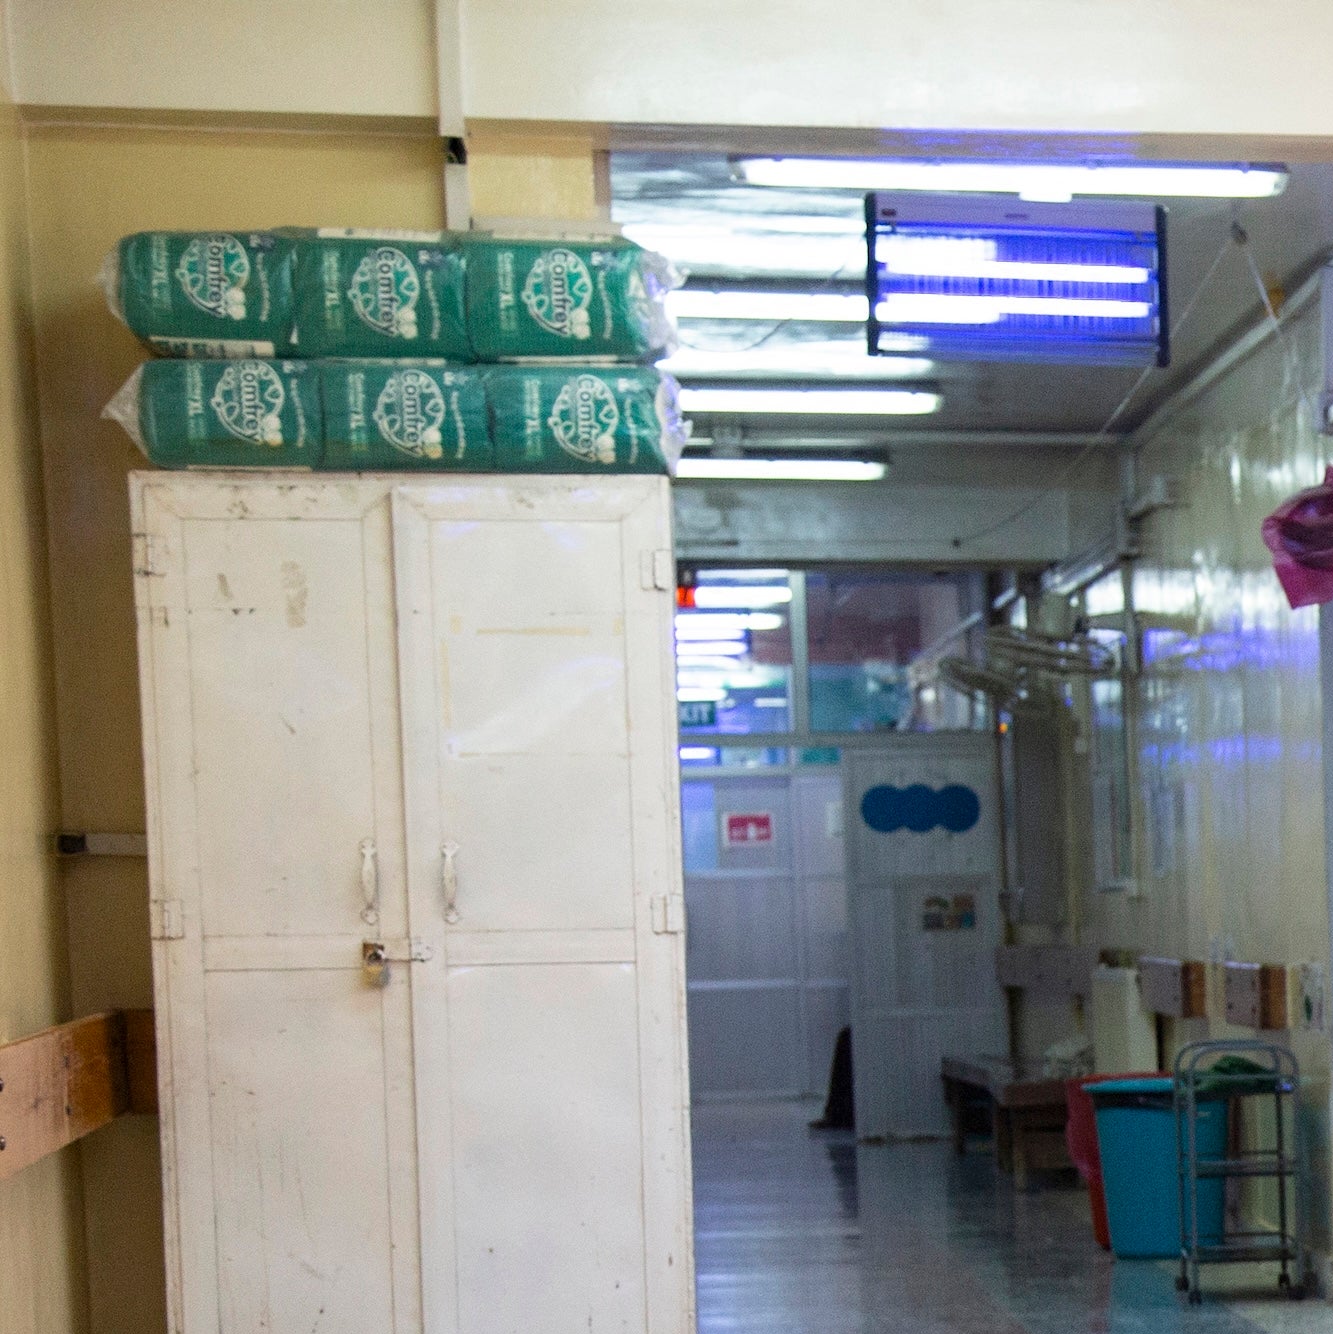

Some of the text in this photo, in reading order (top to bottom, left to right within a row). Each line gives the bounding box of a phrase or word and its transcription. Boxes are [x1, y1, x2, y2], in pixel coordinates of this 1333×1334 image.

[376, 248, 399, 336] Comfrey
[551, 250, 573, 336] Comfrey
[240, 360, 264, 443] Comfrey
[402, 370, 426, 455] Comfrey
[577, 376, 600, 459] Comfrey
